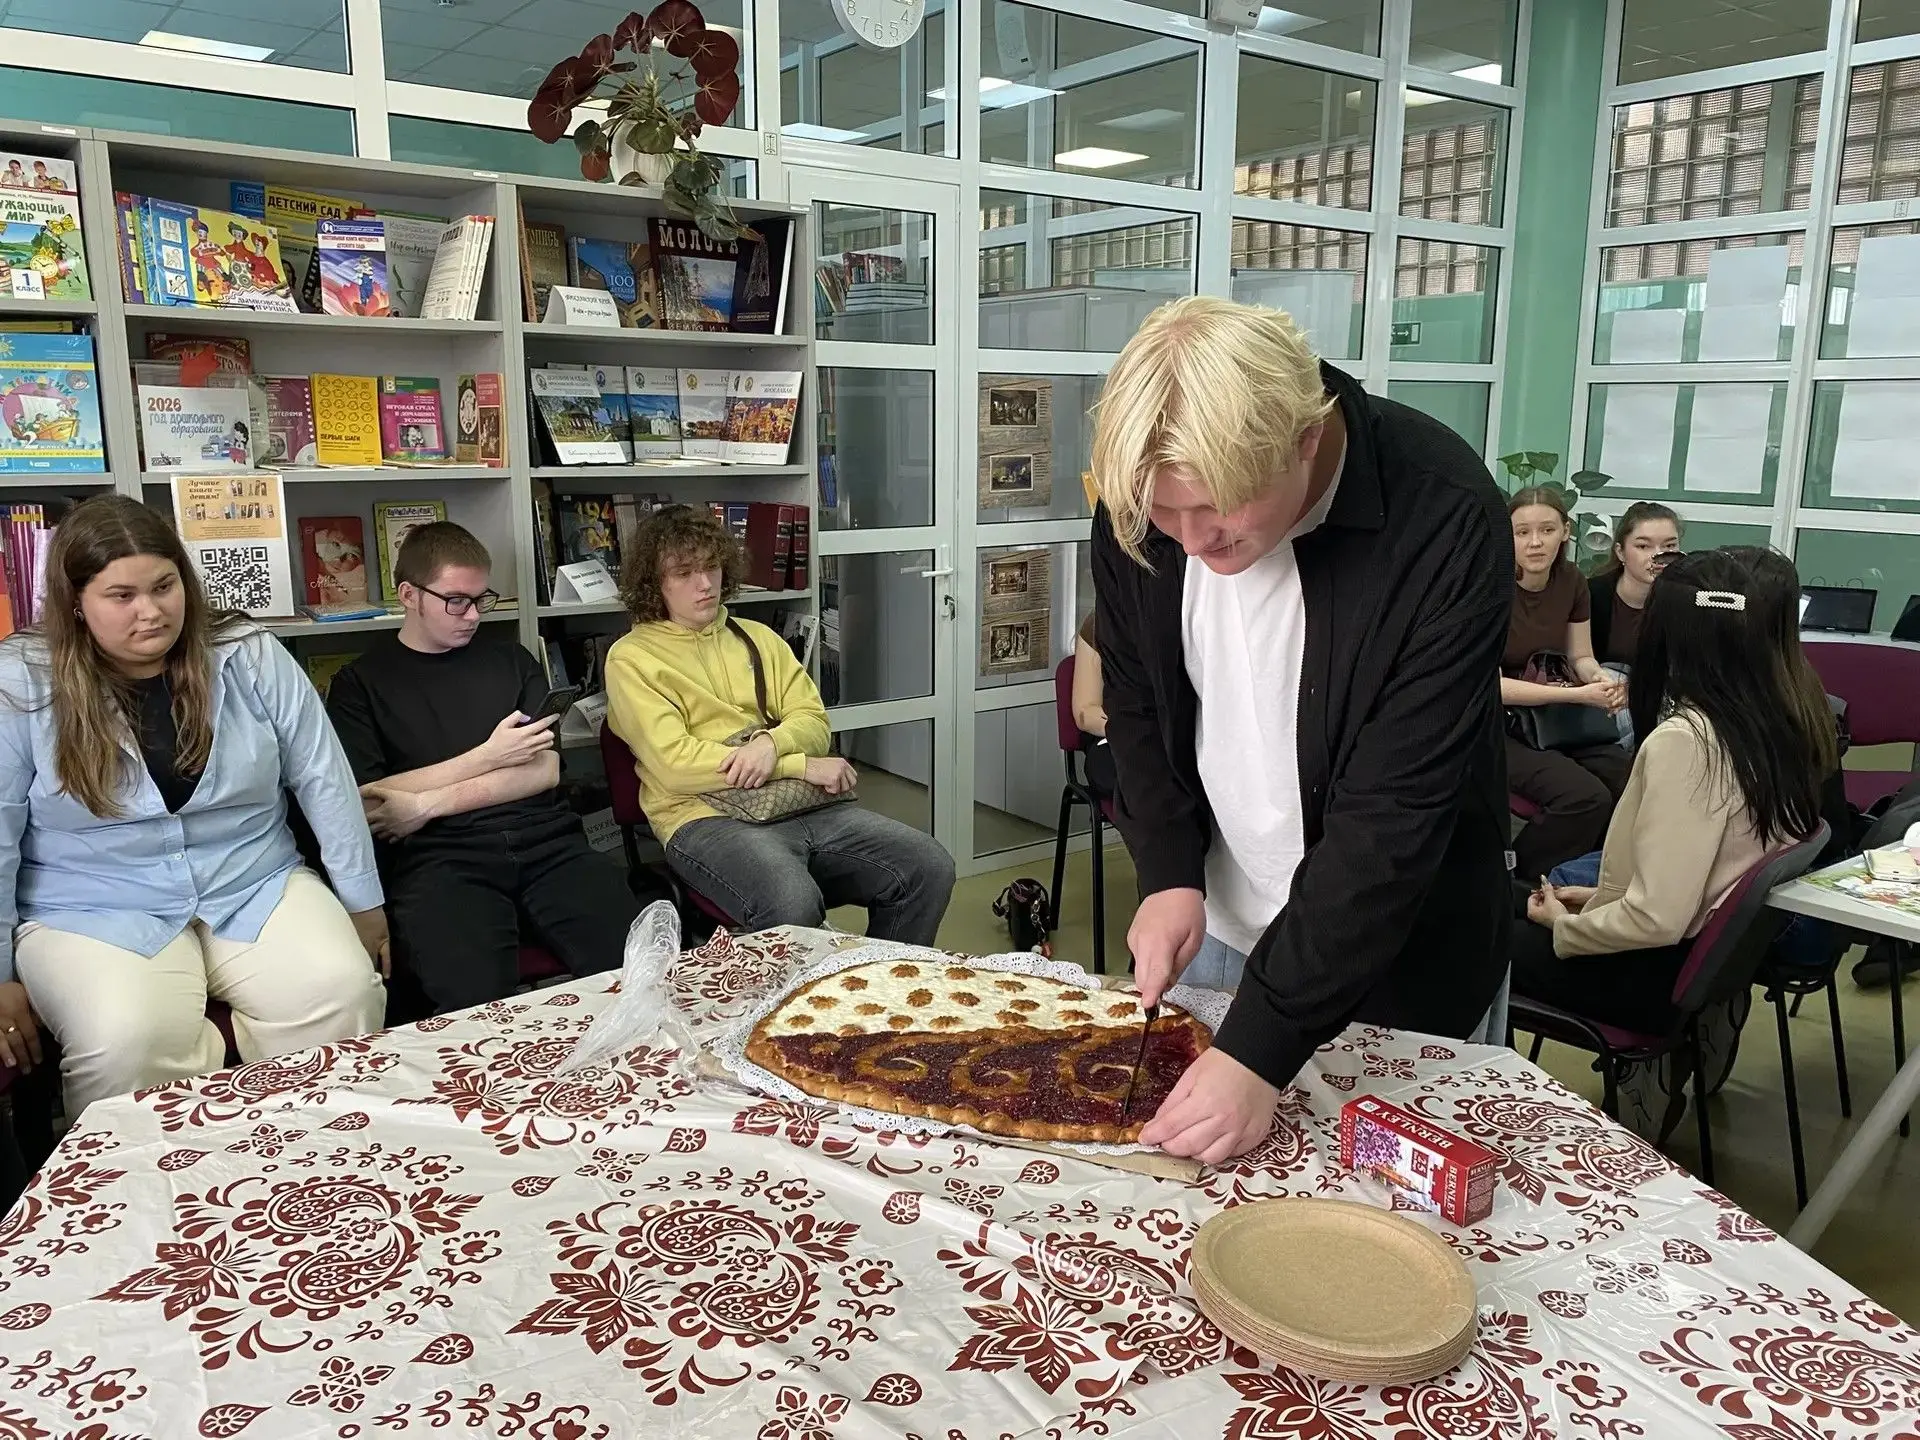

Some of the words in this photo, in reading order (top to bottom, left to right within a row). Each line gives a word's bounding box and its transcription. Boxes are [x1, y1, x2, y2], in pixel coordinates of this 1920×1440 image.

[861, 16, 869, 32] 7
[901, 9, 909, 25] 4
[874, 23, 883, 39] 6
[889, 21, 899, 38] 5
[236, 192, 264, 205] ДЕТС
[268, 195, 317, 214] ДЕТСКИЙ
[320, 205, 341, 220] САД
[22, 273, 30, 286] 1
[610, 274, 634, 287] 100
[147, 397, 182, 412] 2026
[1376, 1111, 1454, 1149] BERNLEY
[1416, 1153, 1427, 1174] 25
[1446, 1165, 1458, 1220] BERNLEY
